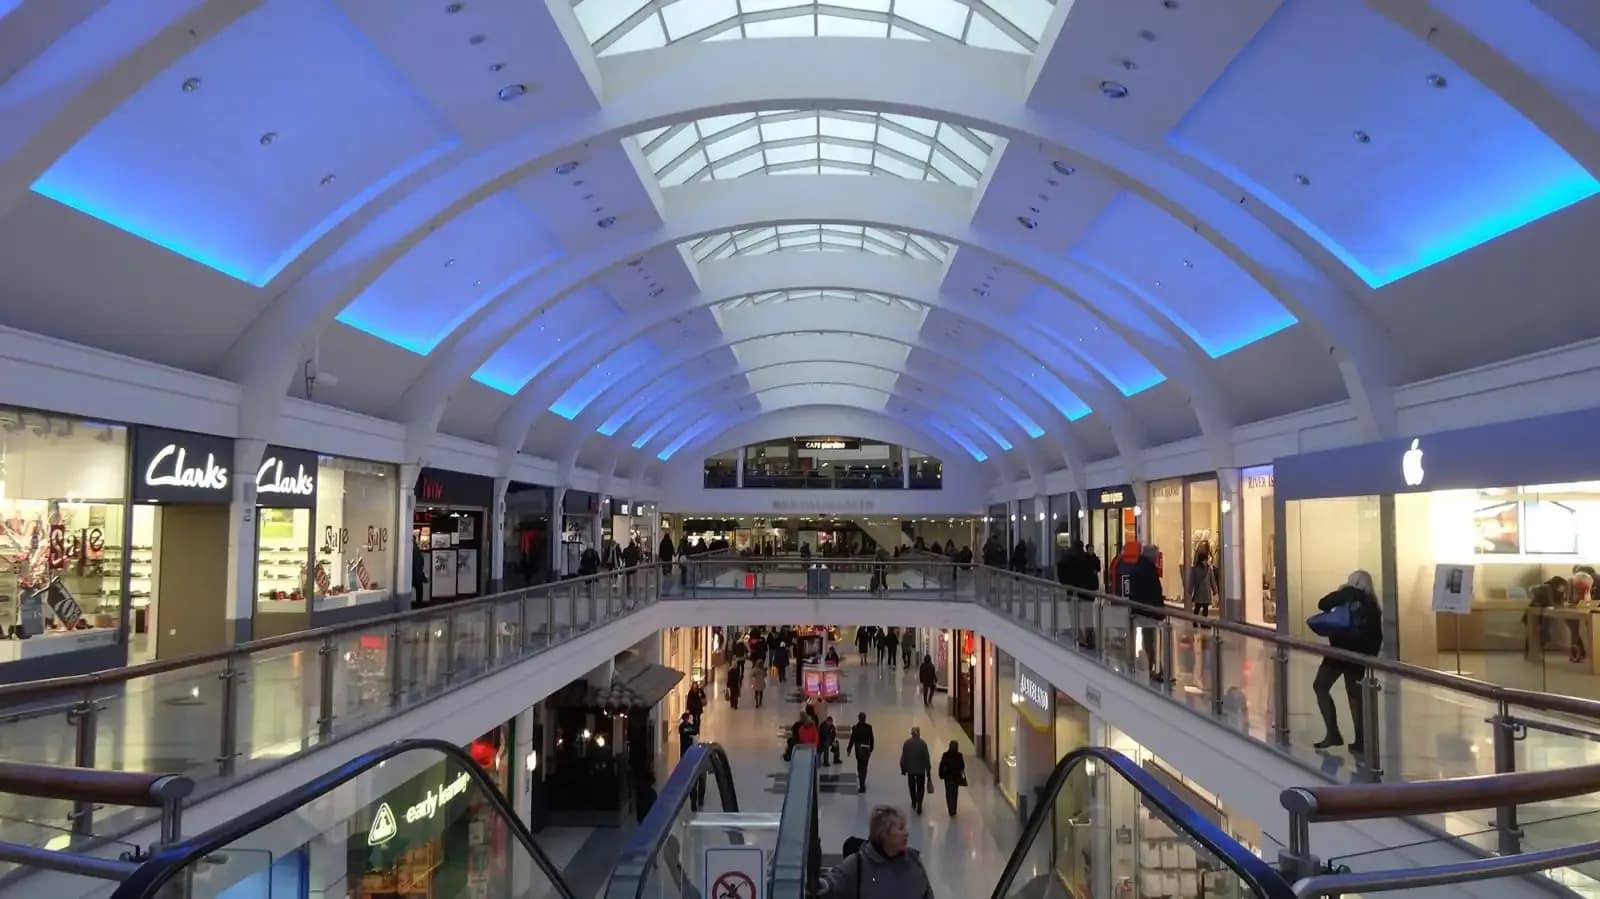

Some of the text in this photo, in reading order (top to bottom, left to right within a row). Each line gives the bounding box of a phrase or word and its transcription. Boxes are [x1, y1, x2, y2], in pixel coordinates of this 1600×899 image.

[145, 444, 228, 489] Clarks
[256, 457, 313, 495] Clarks
[50, 525, 104, 576] Sale
[326, 525, 349, 553] Sale
[368, 525, 387, 552] Sale
[406, 791, 438, 823] early
